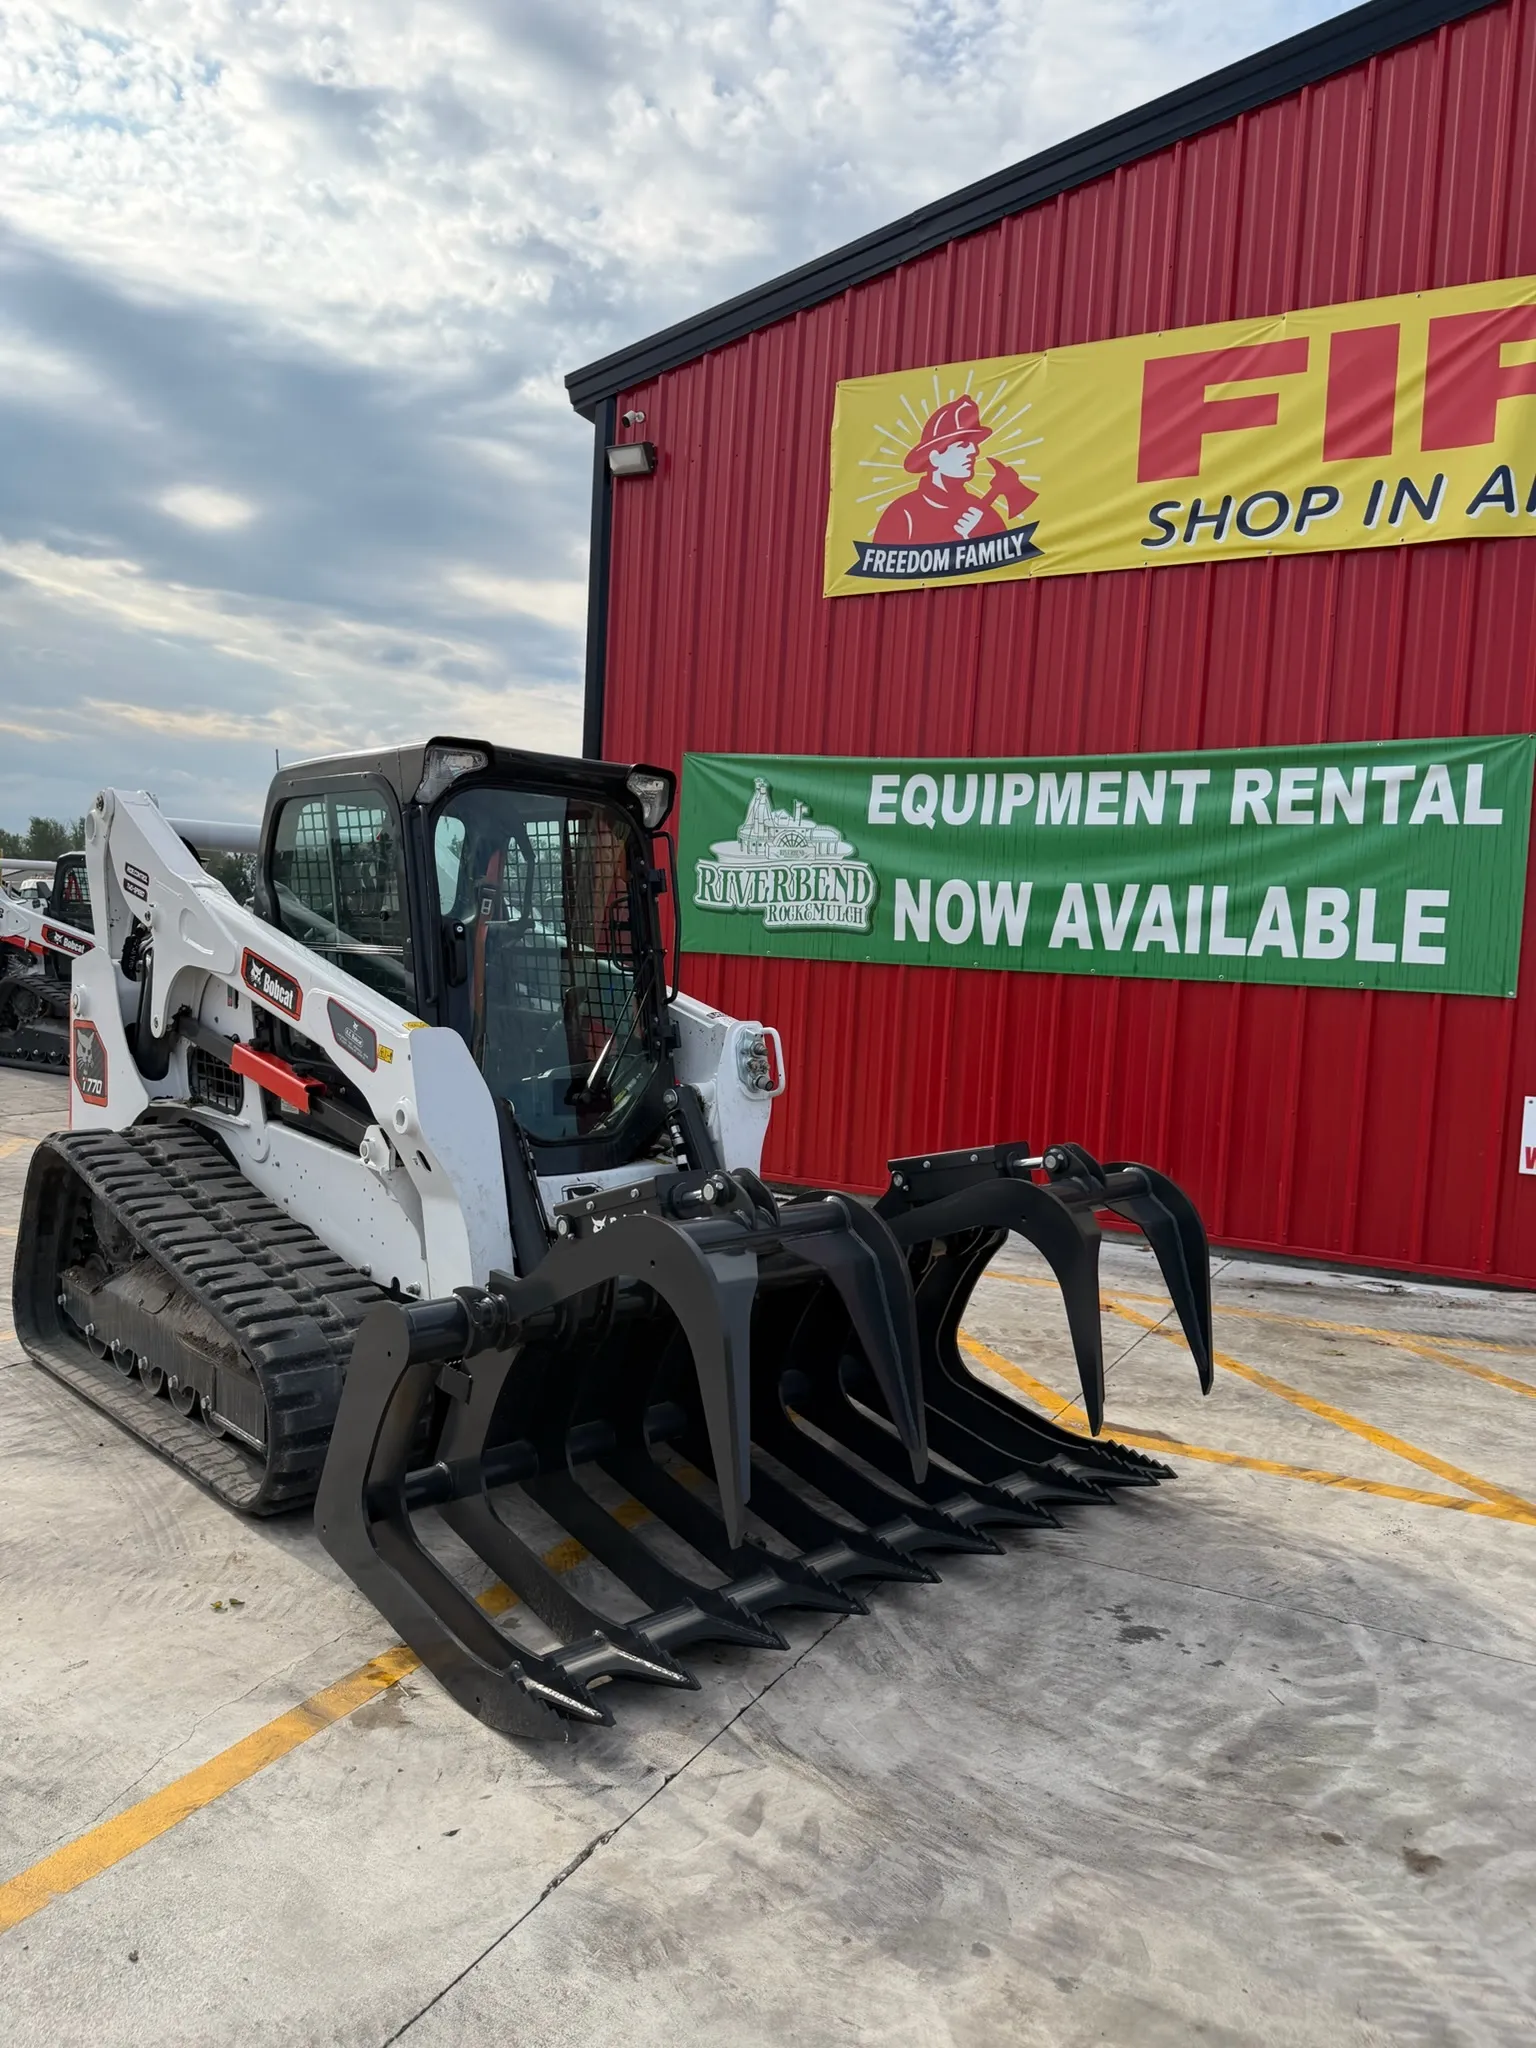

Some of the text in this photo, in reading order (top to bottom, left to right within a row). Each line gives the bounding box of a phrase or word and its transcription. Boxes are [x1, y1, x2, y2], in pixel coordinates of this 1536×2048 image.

[1140, 465, 1536, 549] SHOP IN A
[862, 532, 1025, 574] FREEDOM FAMILY
[867, 763, 1503, 830] EQUIPMENT RENTAL
[696, 864, 873, 905] RIVERBEND
[894, 878, 1451, 965] NOW AVAILABLE
[63, 937, 85, 954] Bobcat
[263, 972, 294, 1010] Bobcat
